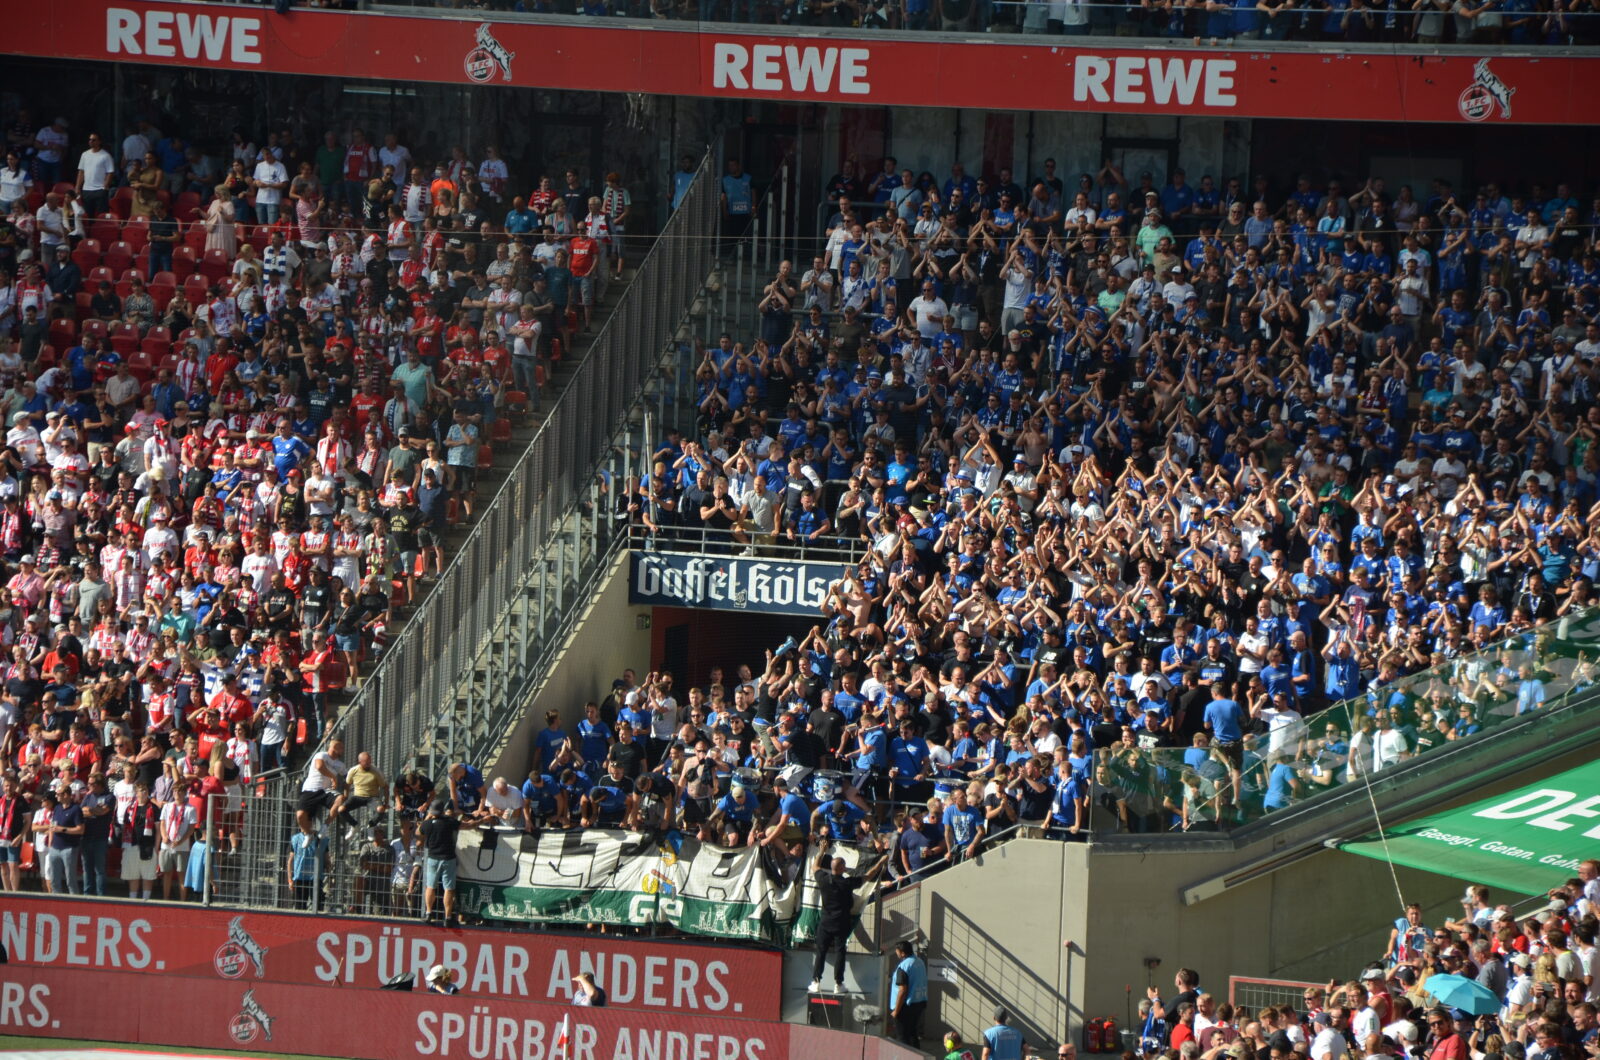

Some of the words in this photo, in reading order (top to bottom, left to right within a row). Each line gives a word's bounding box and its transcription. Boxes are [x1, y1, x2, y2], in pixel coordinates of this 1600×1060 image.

[106, 8, 262, 64] REWE
[713, 42, 870, 94] REWE
[1073, 55, 1237, 107] REWE
[637, 556, 742, 603] Gaffel
[1480, 841, 1535, 859] Getan.
[1, 911, 165, 970] NDERS.
[314, 926, 530, 996] SPÜRBAR
[546, 949, 743, 1013] ANDERS.
[414, 1005, 598, 1060] SPÜRBAR
[612, 1026, 767, 1060] ANDERS
